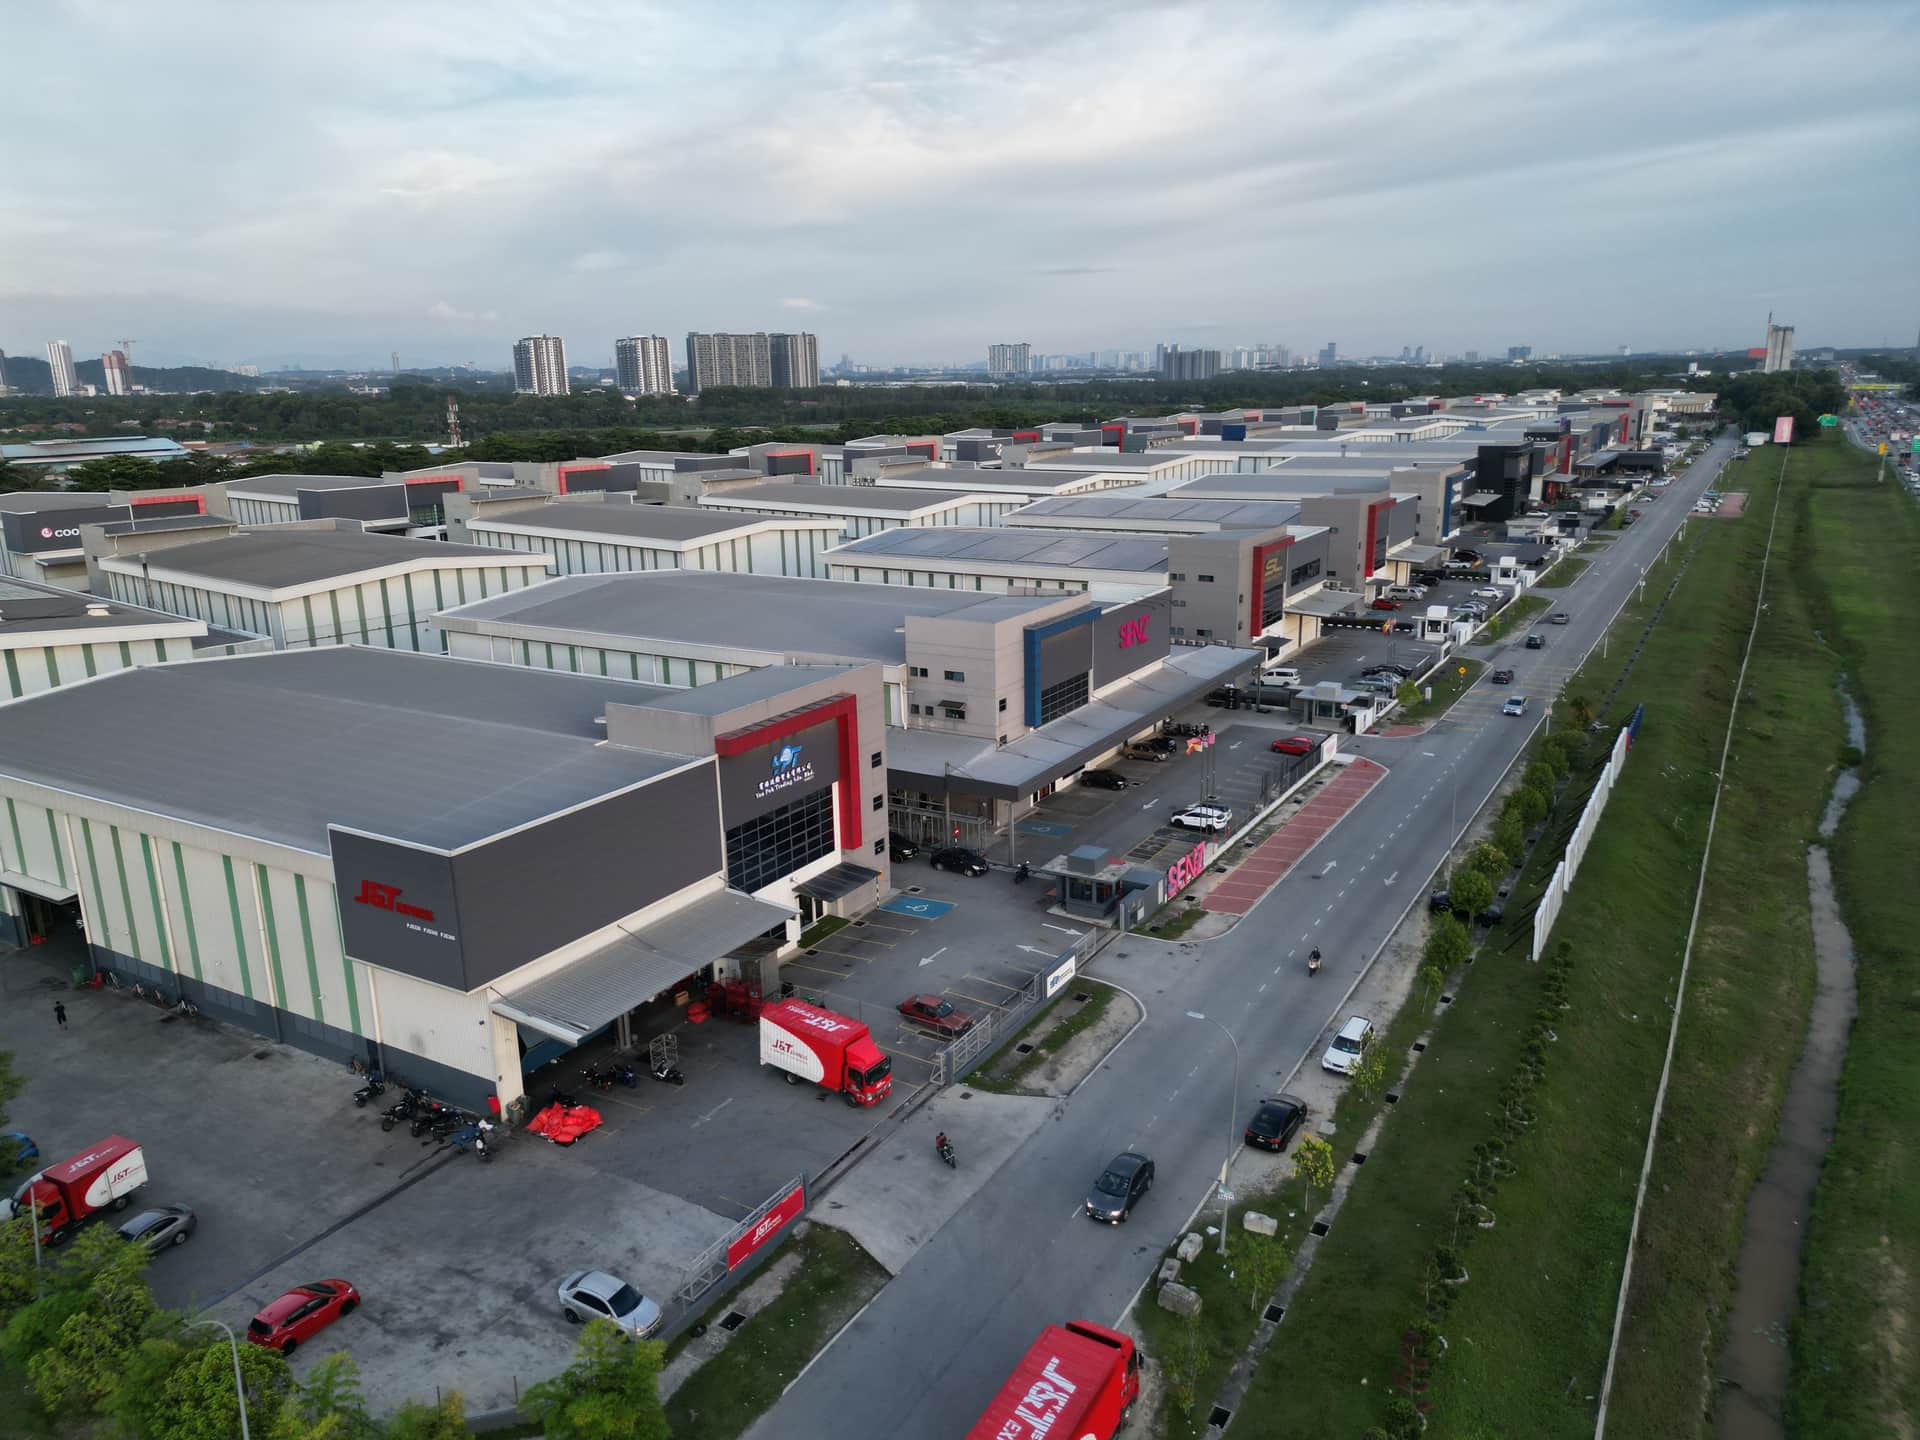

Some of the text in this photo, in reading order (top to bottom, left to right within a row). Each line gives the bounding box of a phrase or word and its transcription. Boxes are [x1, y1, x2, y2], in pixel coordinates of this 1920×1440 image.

[1167, 840, 1207, 898] SENZ
[771, 1039, 794, 1053] J&T
[110, 1167, 131, 1185] J&T
